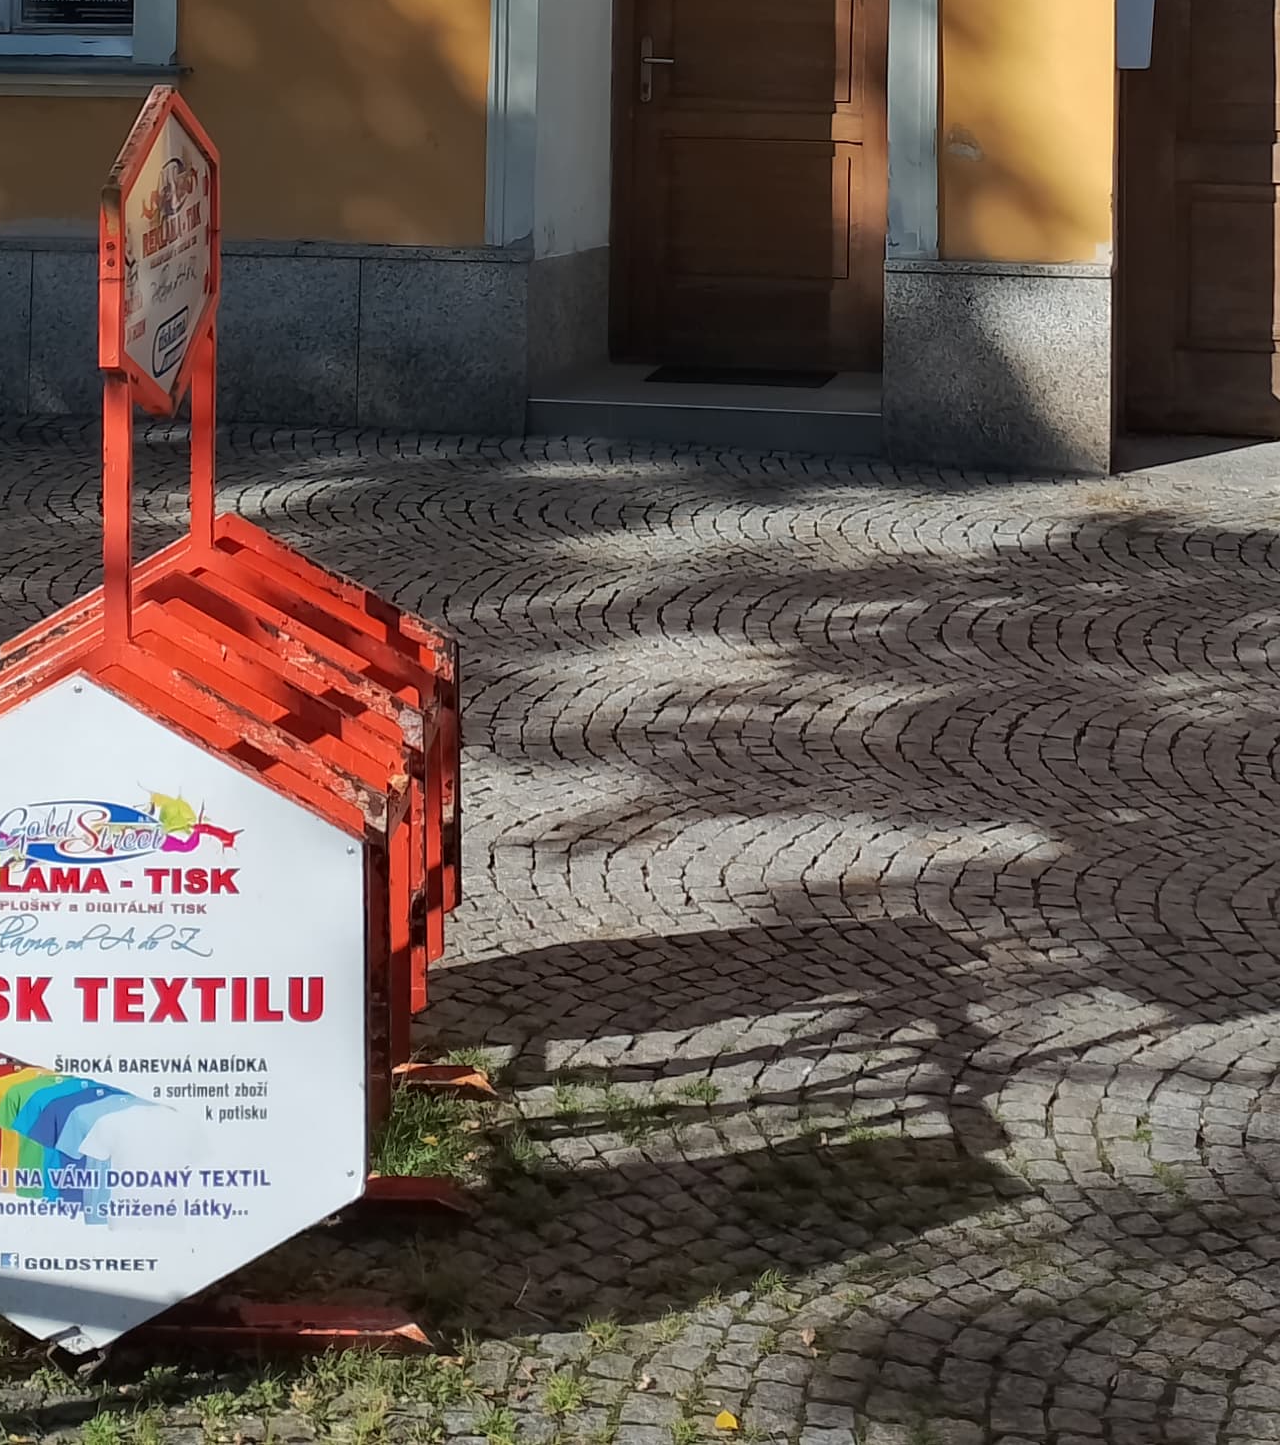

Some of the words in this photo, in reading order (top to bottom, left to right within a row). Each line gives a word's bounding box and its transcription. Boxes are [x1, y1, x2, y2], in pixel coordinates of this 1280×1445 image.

[120, 879, 134, 888] -
[144, 867, 241, 894] TISK
[85, 901, 164, 914] DIGITÁLNÍ
[170, 903, 208, 915] TISK
[137, 924, 175, 950] do
[170, 927, 214, 958] Z
[73, 976, 327, 1024] TEXTILU
[54, 1056, 114, 1074] ŠIROKÁ
[118, 1056, 193, 1074] BAREVNÁ
[197, 1057, 269, 1074] NABÍDKA
[153, 1087, 162, 1099] a
[165, 1083, 231, 1100] sortiment
[234, 1083, 269, 1100] zboží
[205, 1106, 214, 1121] k
[219, 1106, 269, 1125] potisku
[2, 1169, 8, 1187] I
[15, 1168, 43, 1188] NA
[50, 1163, 100, 1189] VÁMI
[106, 1165, 193, 1188] DODANÝ
[198, 1169, 272, 1188] TEXTIL
[98, 1197, 178, 1217] střižené
[183, 1197, 249, 1220] látky...
[24, 1257, 158, 1272] GOLDSTREET
